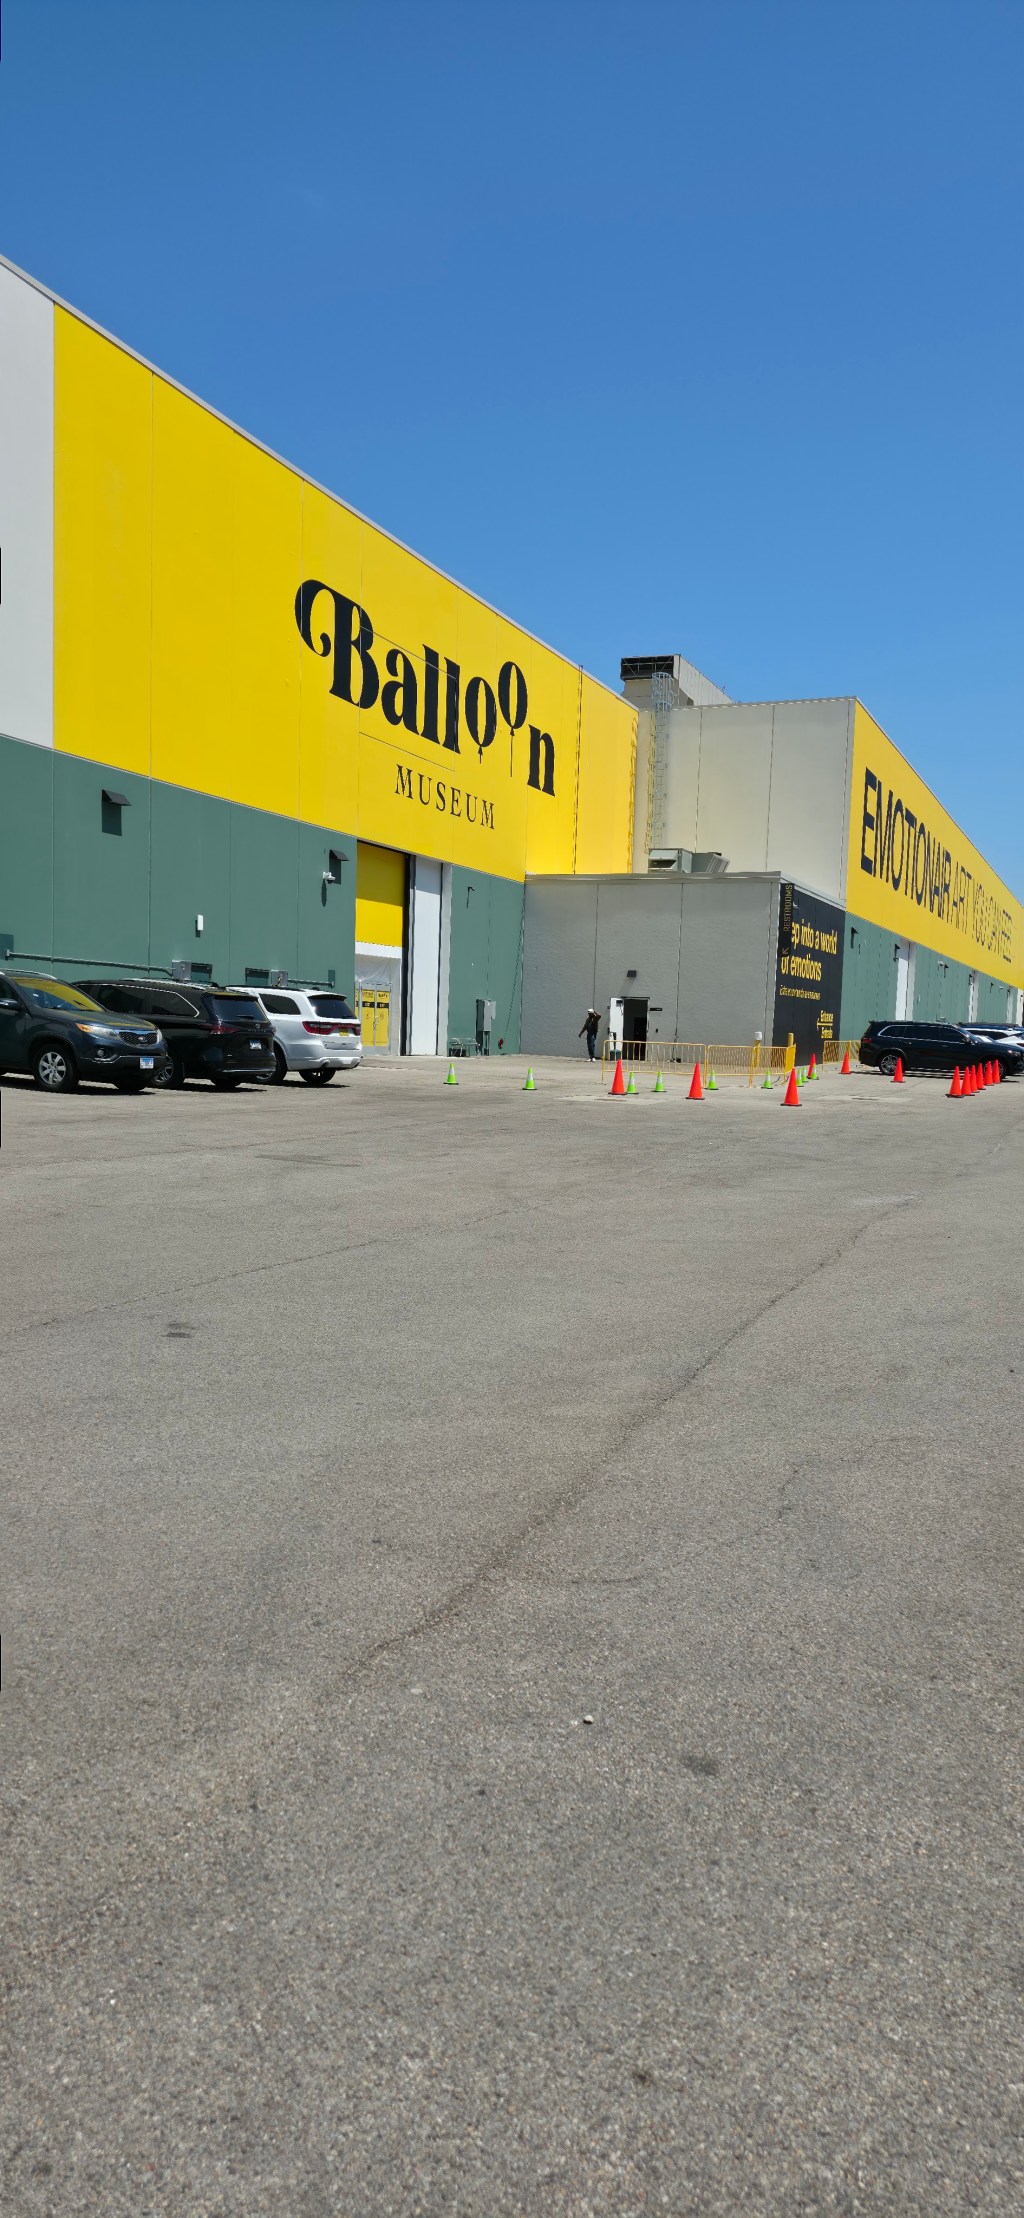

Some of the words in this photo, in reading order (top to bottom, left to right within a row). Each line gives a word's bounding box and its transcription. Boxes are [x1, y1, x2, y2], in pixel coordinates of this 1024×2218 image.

[294, 579, 555, 797] Balloon
[395, 763, 495, 830] MUSEUM
[861, 767, 952, 923] EMOTIONAIR
[951, 861, 972, 934] ART
[783, 884, 793, 932] RESTROOMS
[801, 918, 814, 948] into
[815, 930, 820, 950] a
[820, 929, 838, 955] world
[790, 953, 822, 981] emotions
